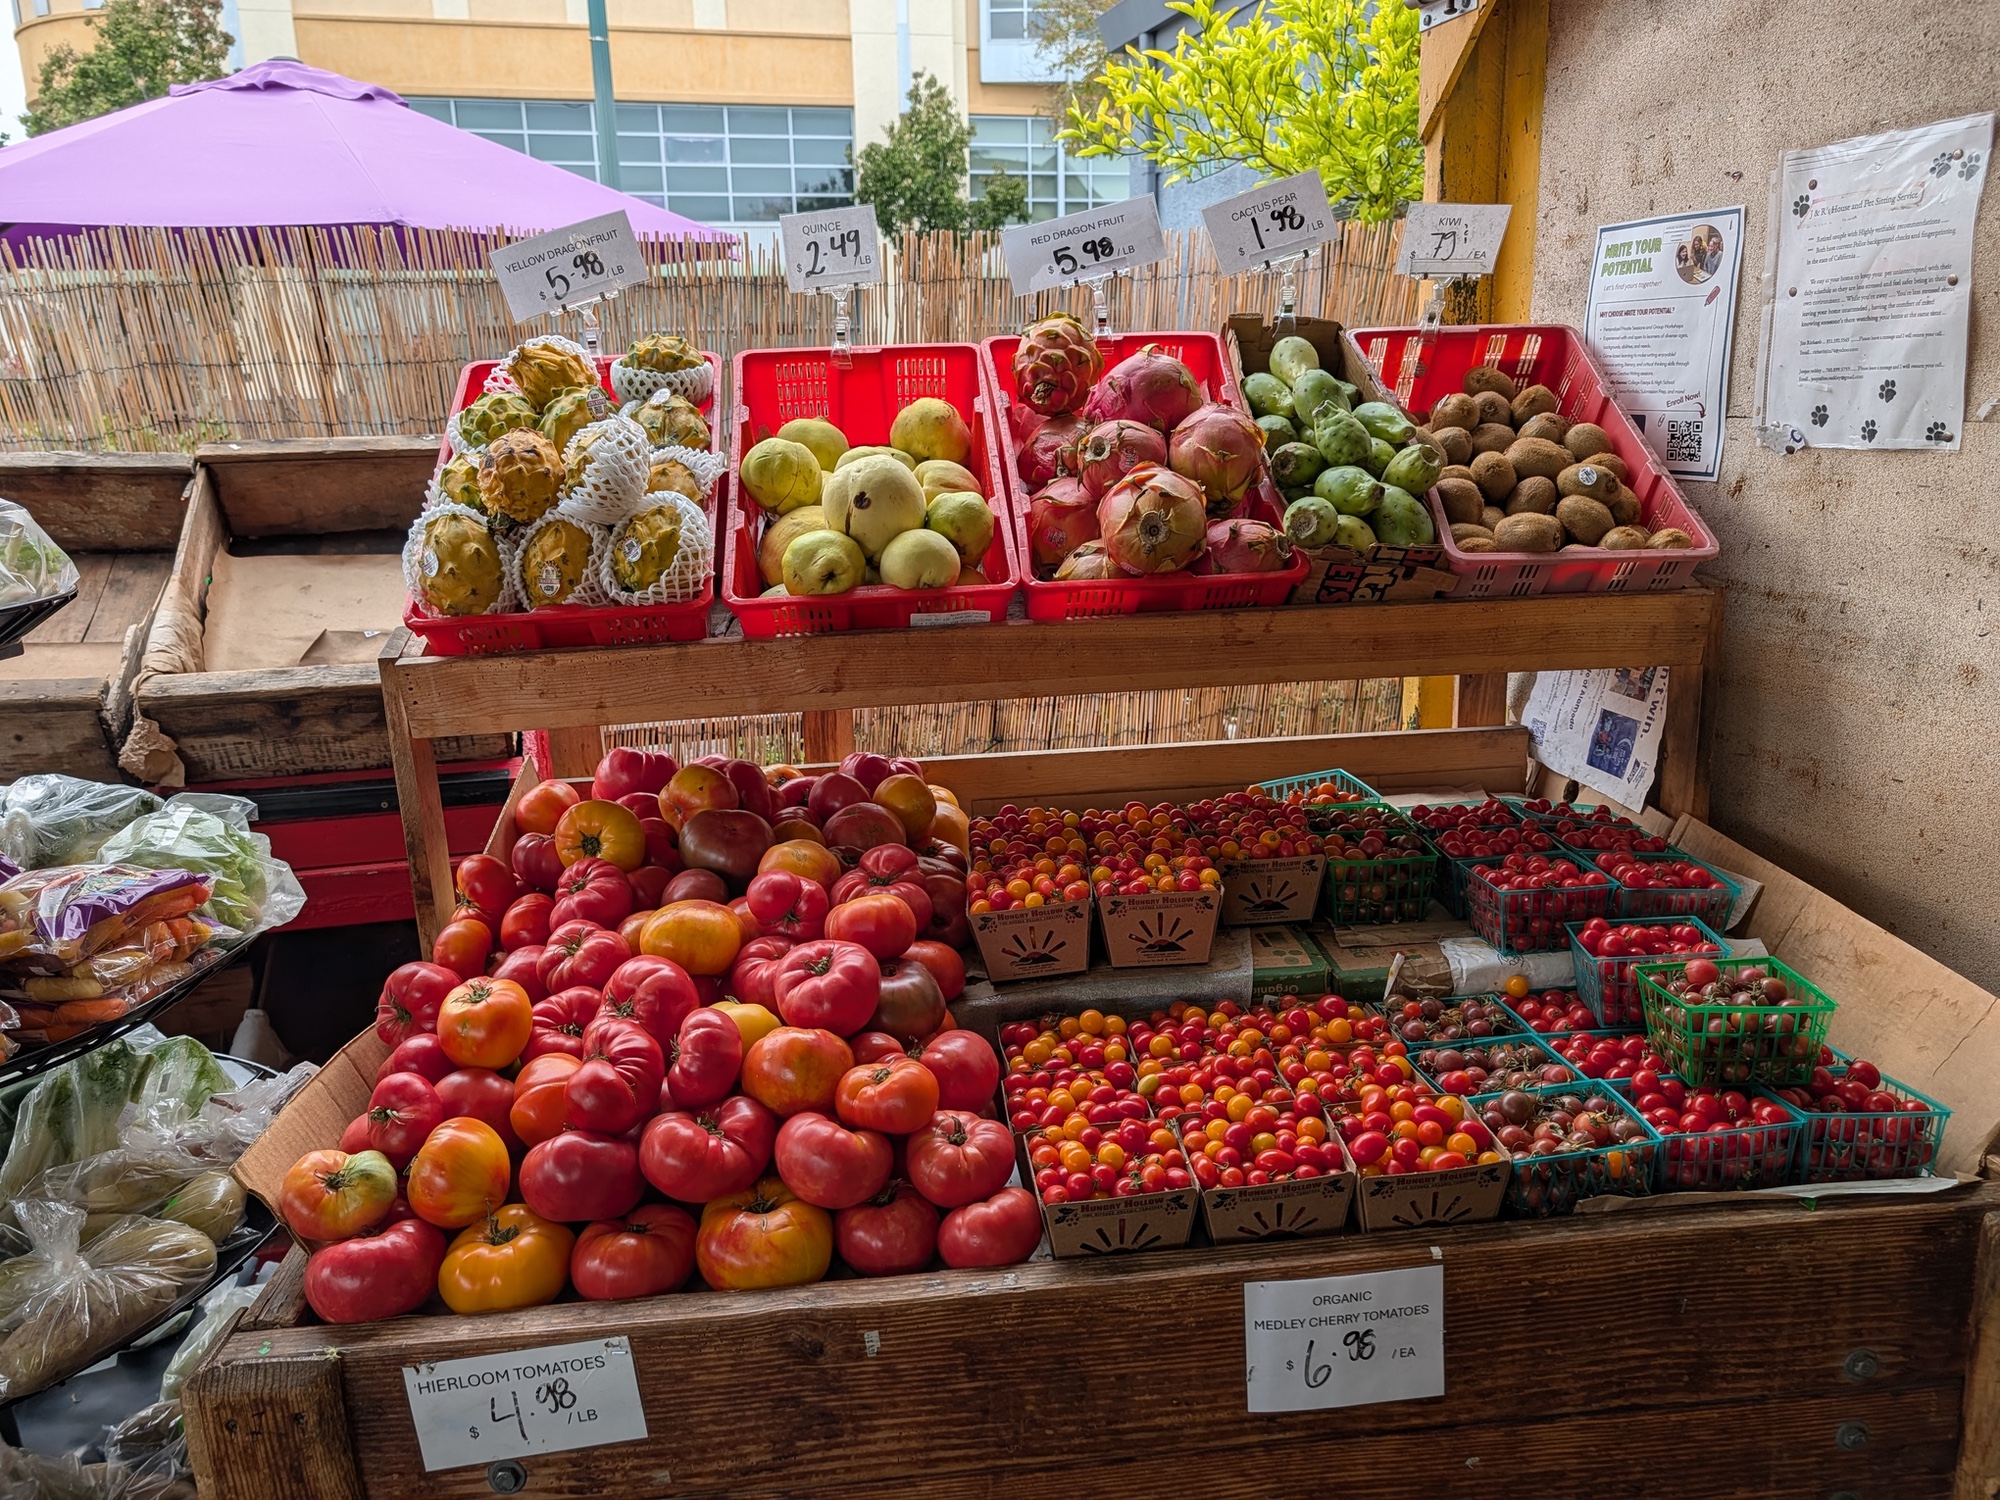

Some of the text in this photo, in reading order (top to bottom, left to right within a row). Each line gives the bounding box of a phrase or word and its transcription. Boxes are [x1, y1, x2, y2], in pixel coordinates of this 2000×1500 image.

[1231, 192, 1298, 221] CACTUS PEAR
[1831, 205, 1850, 213] House
[1851, 200, 1863, 210] and
[1864, 199, 1874, 207] Pet
[1875, 196, 1895, 205] Sitting
[1897, 192, 1918, 201] Service
[802, 221, 841, 236] QUINCE
[1031, 214, 1125, 246] RED DRAGON FRUIT
[1438, 217, 1462, 226] KIWI
[1817, 234, 1832, 242] Retired
[1832, 232, 1846, 241] couple
[1858, 227, 1874, 237] Highly
[1897, 219, 1940, 230] recommendations
[1604, 237, 1662, 259] WRITE YOUR
[1867, 235, 1894, 246] background
[1895, 233, 1910, 241] checks
[805, 230, 860, 278] 2.49
[1053, 237, 1114, 275] 5.98
[1835, 253, 1855, 261] California
[505, 253, 546, 274] YELLOW
[1601, 257, 1653, 277] POTENTIAL
[1860, 273, 1871, 281] keep
[1624, 283, 1638, 291] yours
[1941, 283, 1955, 292] about
[1666, 391, 1702, 408] Enroll Now!
[1582, 679, 1589, 689] of
[1569, 689, 1586, 730] Alameda
[1640, 667, 1669, 739] n't win.
[1128, 897, 1159, 906] HUNGRY
[1162, 895, 1194, 904] HOLLOW
[997, 912, 1029, 921] HUNGRY
[1031, 907, 1063, 918] HOLLOW
[1396, 1175, 1436, 1186] HUNGRY
[1440, 1170, 1478, 1182] HOLLOW
[1238, 1188, 1279, 1197] HUNGRY
[1281, 1182, 1322, 1193] HOLLOW
[1081, 1203, 1120, 1212] HUNGRY
[1124, 1197, 1164, 1208] HOLLOW
[1312, 1290, 1372, 1306] ORGANIC
[1254, 1304, 1429, 1330] MEDLEY CHERRY TOMATOES
[1286, 1360, 1294, 1371] $
[1305, 1328, 1376, 1389] 6.98
[418, 1355, 605, 1395] HIERLOOM TOMATOES
[469, 1425, 480, 1439] $
[490, 1377, 577, 1441] 4.98
